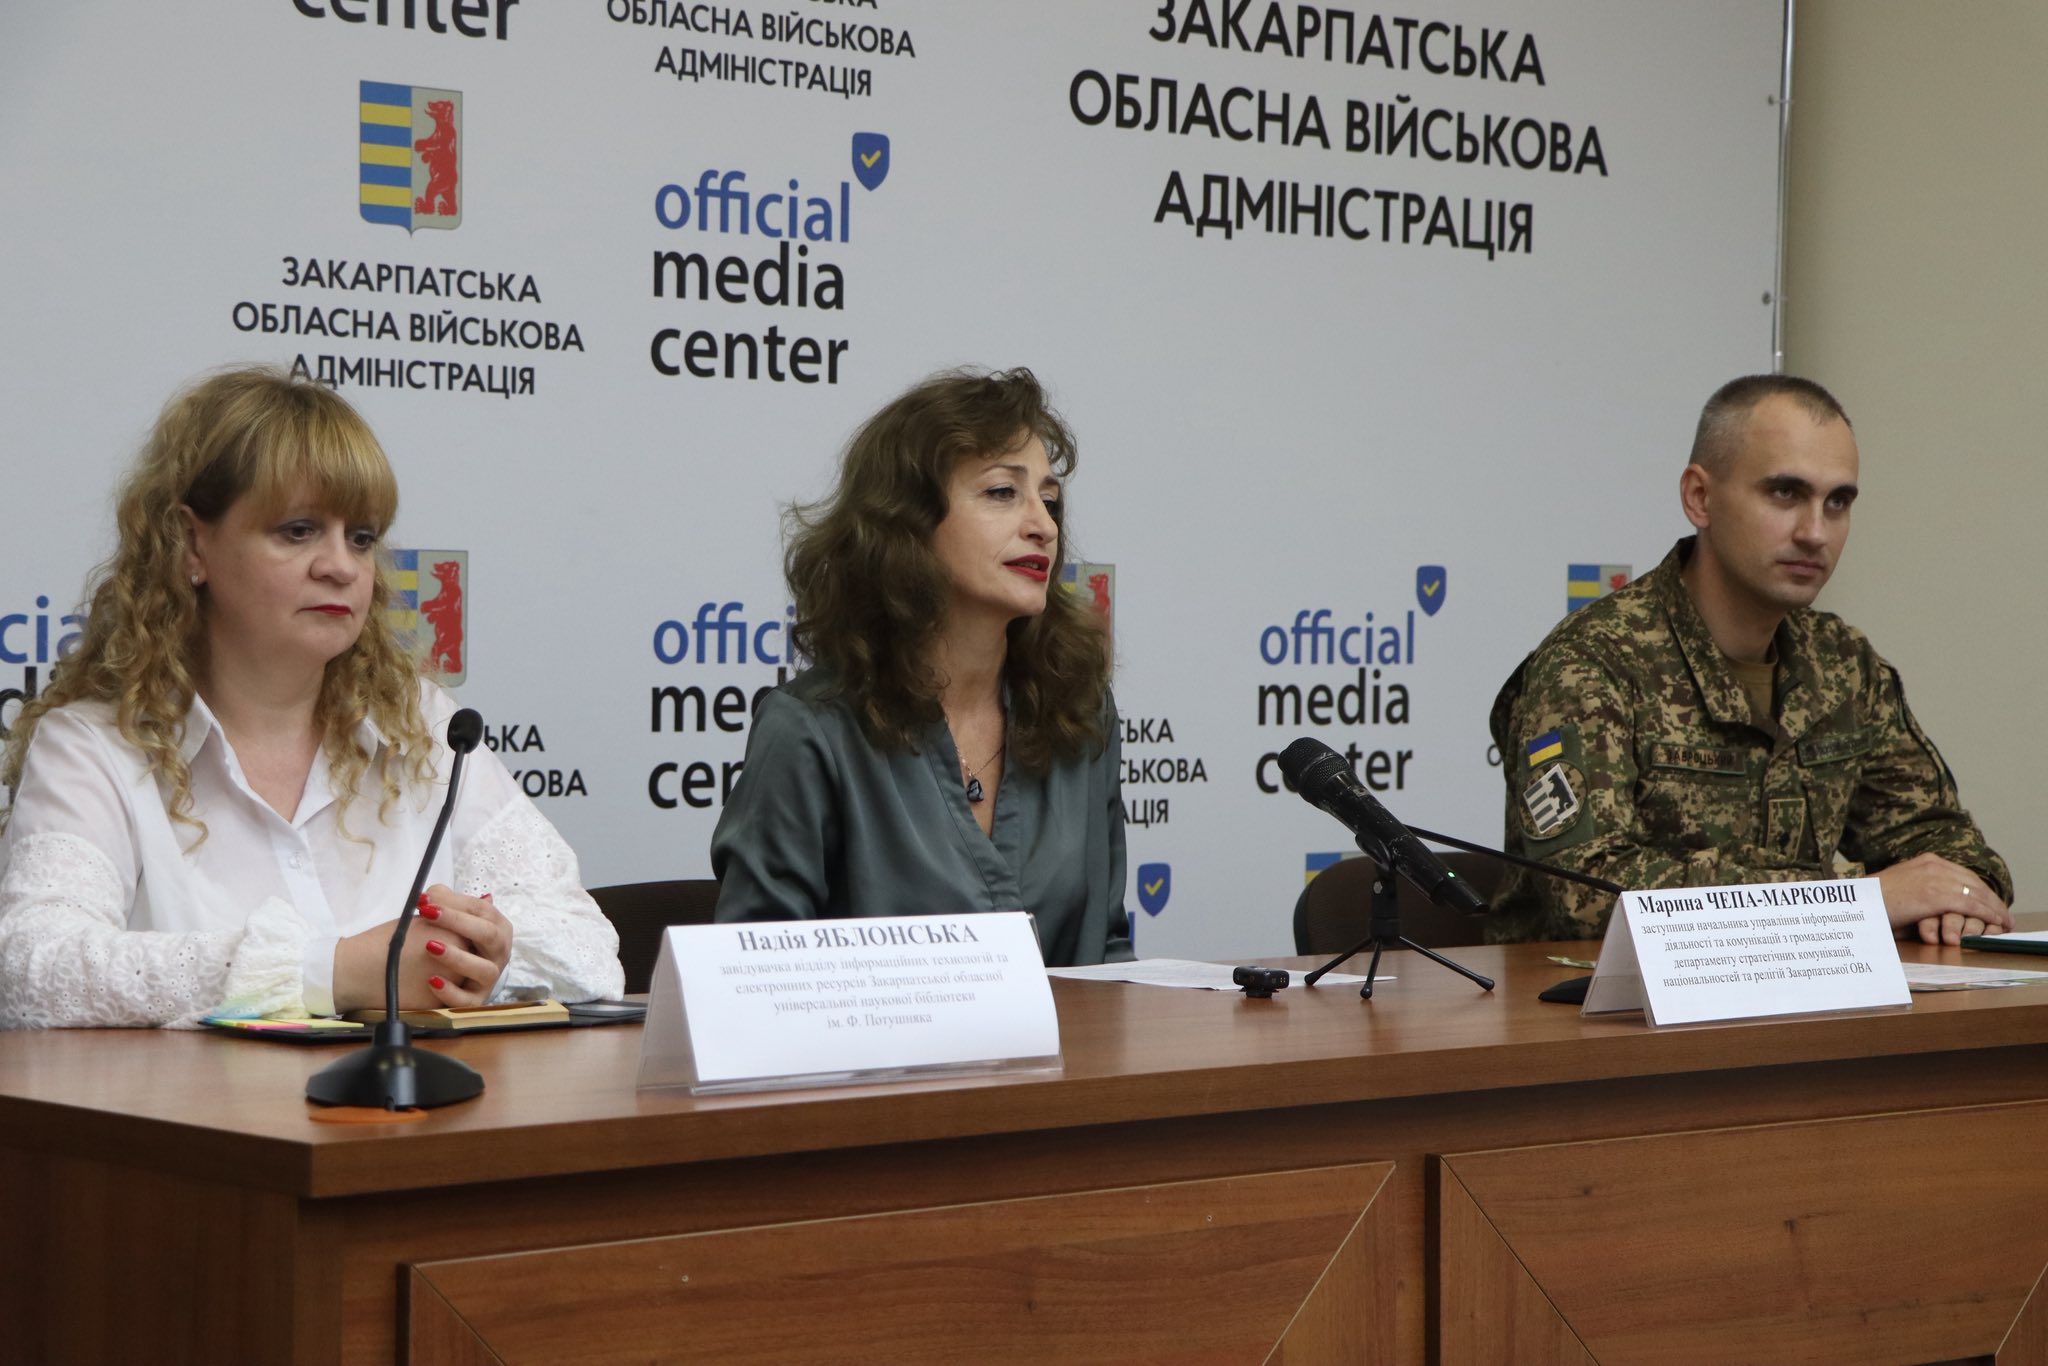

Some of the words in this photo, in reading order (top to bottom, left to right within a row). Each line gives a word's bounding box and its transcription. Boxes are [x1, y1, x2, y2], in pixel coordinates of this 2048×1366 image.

[606, 0, 753, 39] ОБЛАСНА
[761, 11, 916, 58] ВІЙСЬКОВА
[1149, 0, 1546, 86] ЗАКАРПАТСЬКА
[655, 46, 872, 99] АДМІНІСТРАЦІЯ
[1069, 69, 1331, 150] ОБЛАСНА
[1345, 95, 1609, 177] ВІЙСЬКОВА
[655, 169, 850, 243] official
[1153, 170, 1534, 261] АДМІНІСТРАЦІЯ
[282, 256, 542, 303] ЗАКАРПАТСЬКА
[653, 241, 845, 310] media
[232, 301, 400, 341] ОБЛАСНА
[409, 309, 585, 352] ВІЙСЬКОВА
[290, 354, 535, 399] АДМІНІСТРАЦІЯ
[650, 325, 849, 384] center
[1260, 609, 1415, 665] official
[1258, 667, 1410, 725] media
[1256, 742, 1413, 794] cter
[1637, 895, 1704, 917] Марина
[1705, 884, 1858, 910] ЧЕПА-МАРКОВЦІ
[1641, 922, 1695, 935] заступниця
[1697, 918, 1749, 931] начальника
[1750, 914, 1800, 930] управління
[1801, 910, 1865, 927] інформаційної
[737, 929, 807, 952] Надія
[813, 924, 979, 948] ЯБЛОНСЬКА
[997, 953, 1009, 963] та
[1664, 936, 1713, 952] діяльності
[1714, 938, 1725, 948] та
[1726, 932, 1781, 949] комунікацій
[1783, 935, 1788, 943] з
[1789, 928, 1854, 946] громадськістю
[1673, 955, 1737, 970] департаменту
[1739, 950, 1796, 967] стратегічних
[1798, 945, 1855, 961] комунікацій,
[1663, 971, 1740, 987] національностей
[1742, 973, 1752, 981] та
[1754, 966, 1786, 983] релігій
[1787, 961, 1849, 980] Закарпатської
[1849, 962, 1873, 974] ОВА
